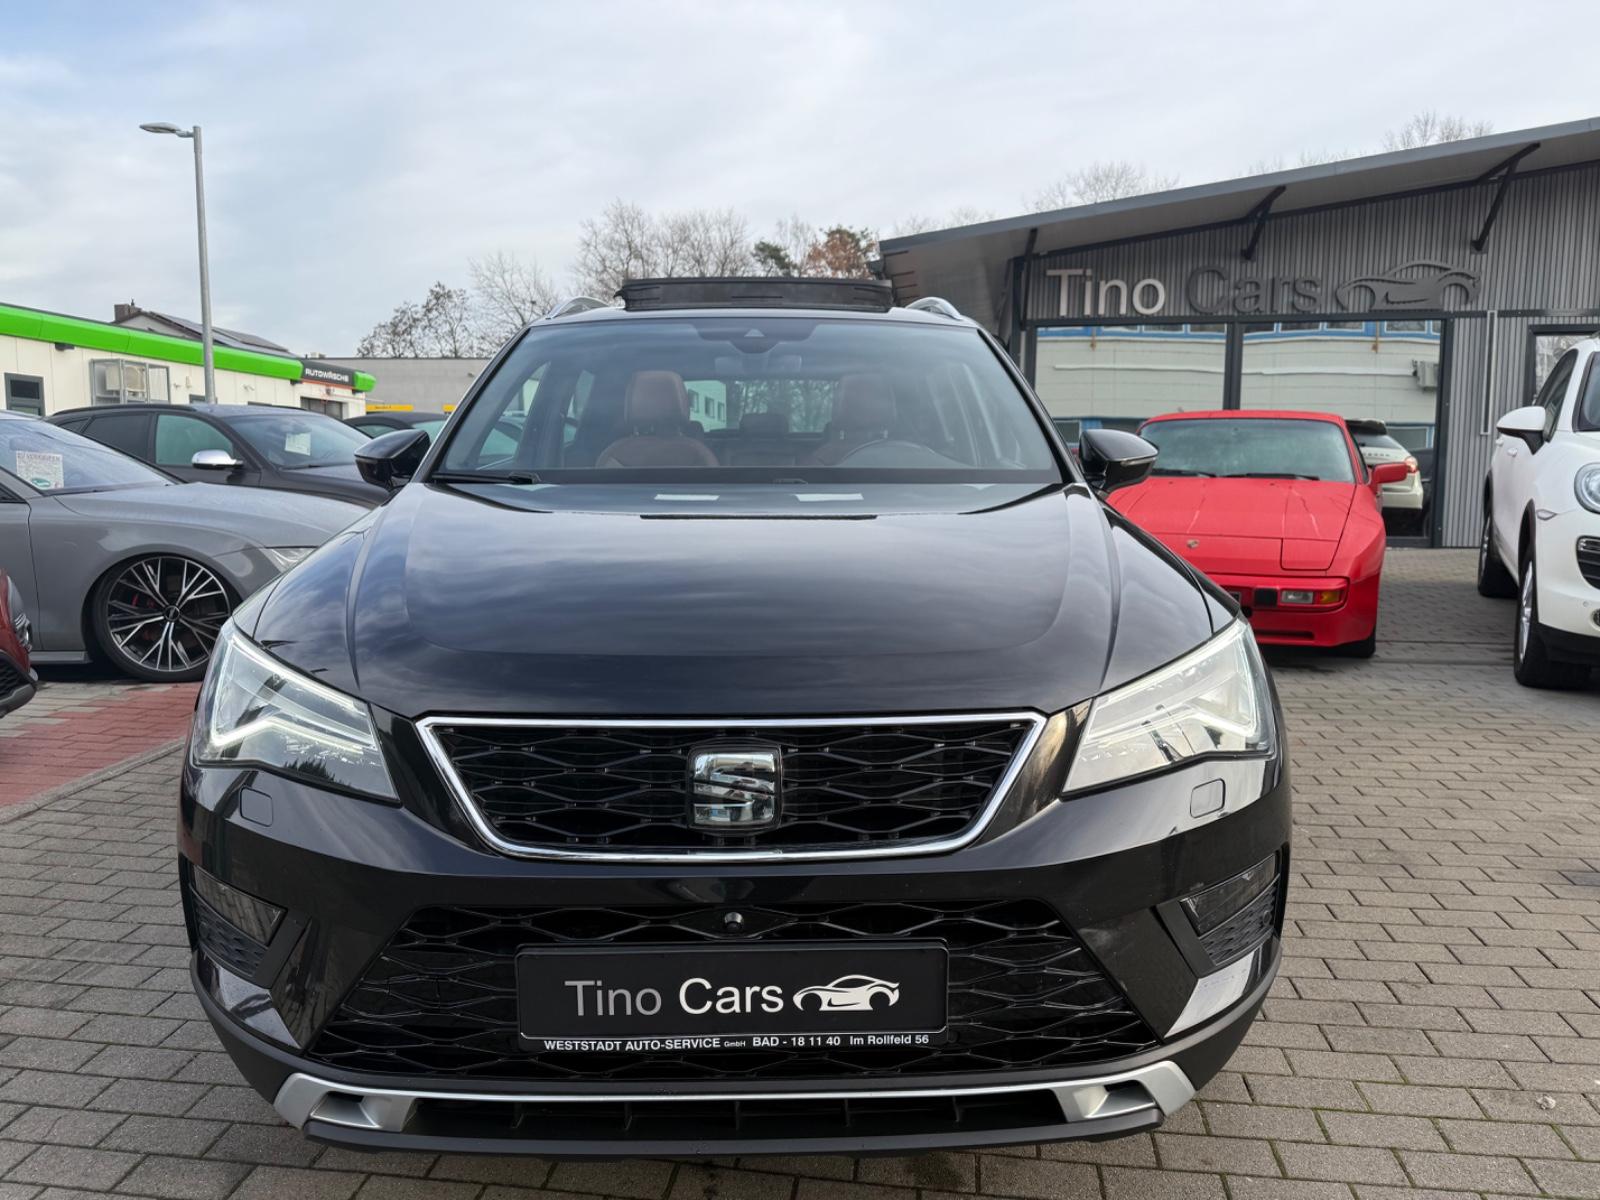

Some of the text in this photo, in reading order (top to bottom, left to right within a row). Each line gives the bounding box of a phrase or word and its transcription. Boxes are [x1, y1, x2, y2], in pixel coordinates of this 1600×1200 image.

[1046, 266, 1322, 316] Tino Cars
[564, 978, 784, 1016] Tino Cars
[544, 1040, 622, 1051] WESTSTADT
[625, 1038, 721, 1050] AUTO-SERVICE
[752, 1037, 780, 1047] BAD
[791, 1036, 805, 1047] 18
[809, 1036, 822, 1046] 11
[826, 1036, 841, 1047] 40
[850, 1035, 864, 1045] Im
[867, 1034, 912, 1045] Rollfeld
[915, 1034, 930, 1044] 56
